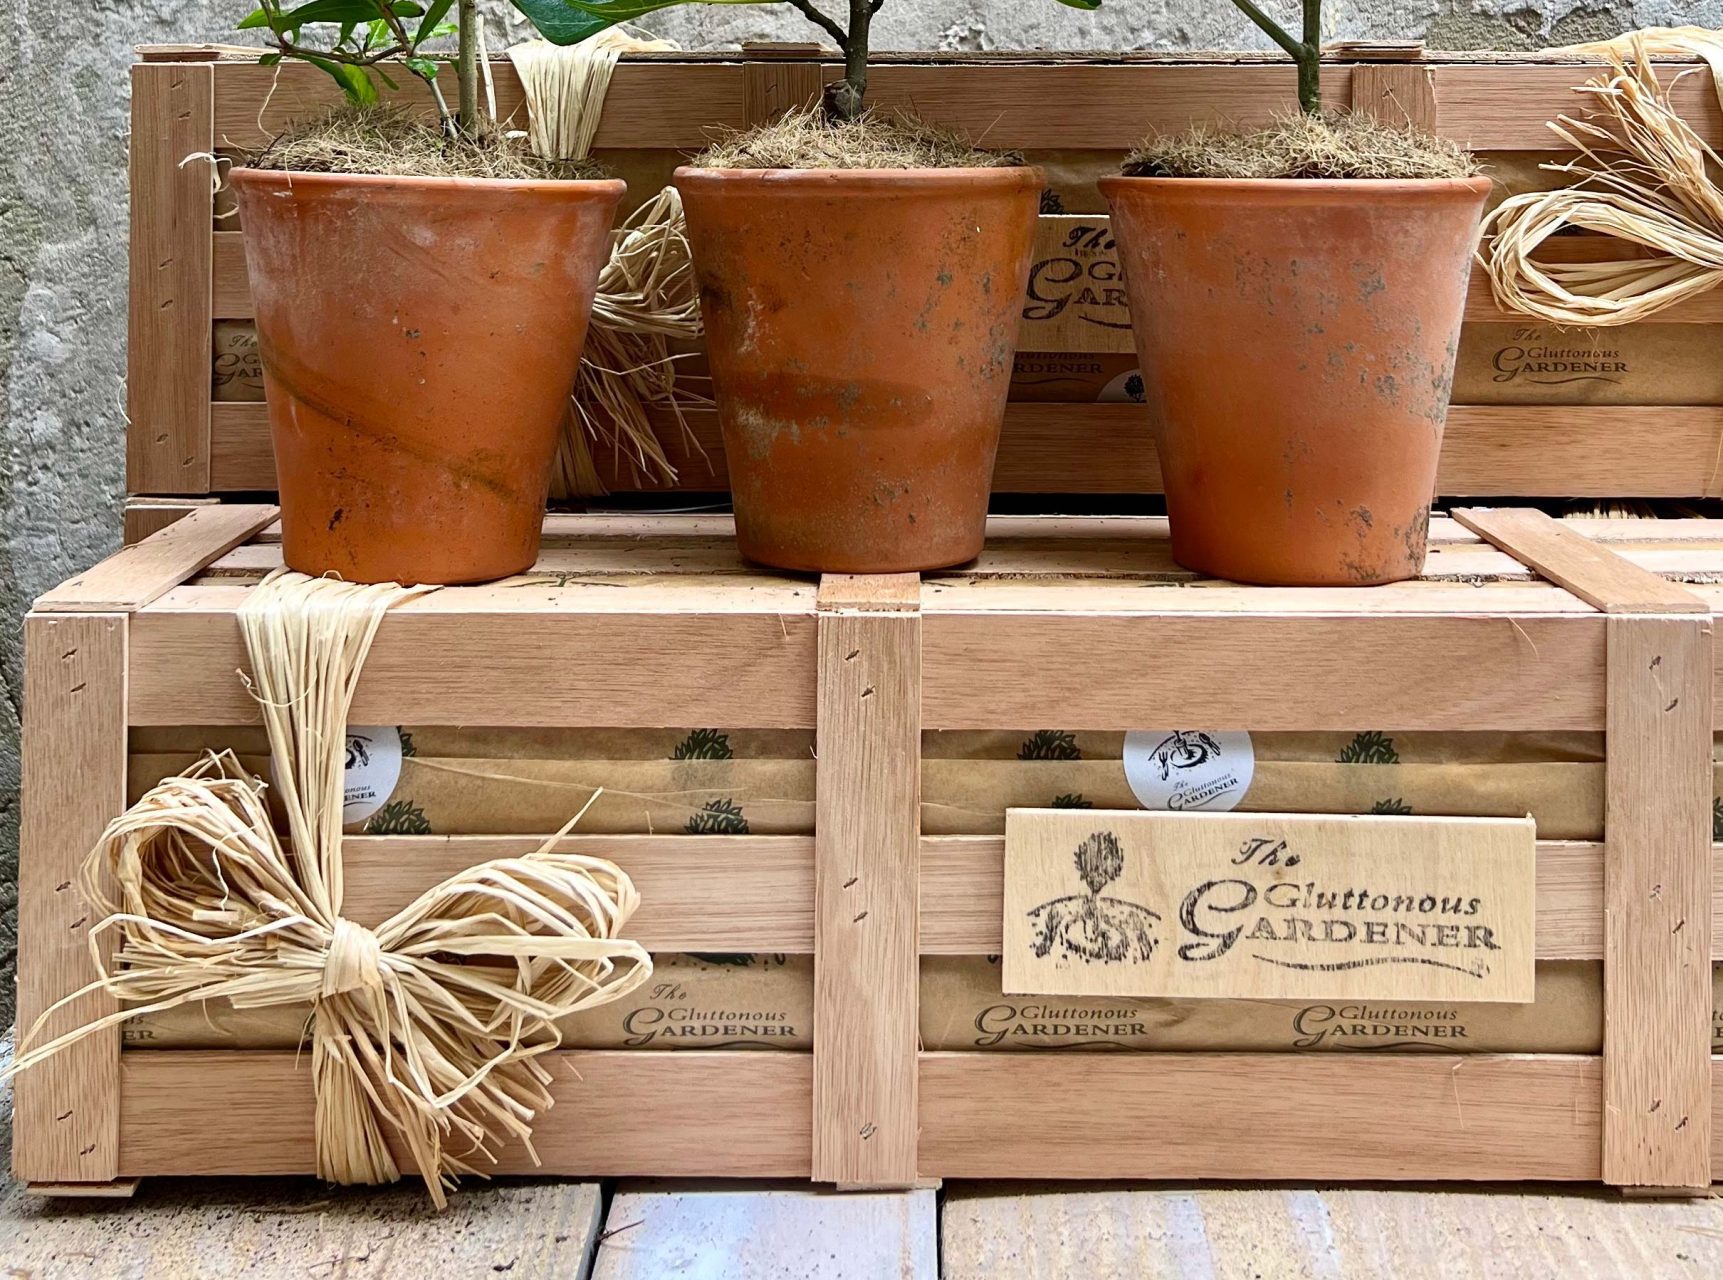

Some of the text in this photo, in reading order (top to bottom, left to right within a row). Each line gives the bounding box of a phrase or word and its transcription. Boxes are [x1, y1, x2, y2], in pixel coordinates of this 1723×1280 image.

[1063, 226, 1117, 249] The
[1512, 328, 1542, 341] The
[1492, 346, 1628, 382] GARDENER
[1527, 347, 1620, 359] Gluttonous
[1014, 363, 1104, 373] RDENER
[1167, 778, 1239, 811] GARDENER
[1183, 773, 1232, 797] Gluttonous
[1231, 837, 1300, 867] The
[1263, 881, 1482, 916] Gluttonous
[1178, 879, 1502, 961] GARDENER
[650, 984, 687, 1000] The
[668, 1007, 787, 1021] Gluttonous
[1020, 1005, 1138, 1020] Gluttonous
[1339, 1005, 1458, 1020] Gluttonous
[623, 1007, 797, 1046] GARDENER
[975, 1005, 1148, 1046] GARDENER
[1293, 1005, 1468, 1048] GARDENER
